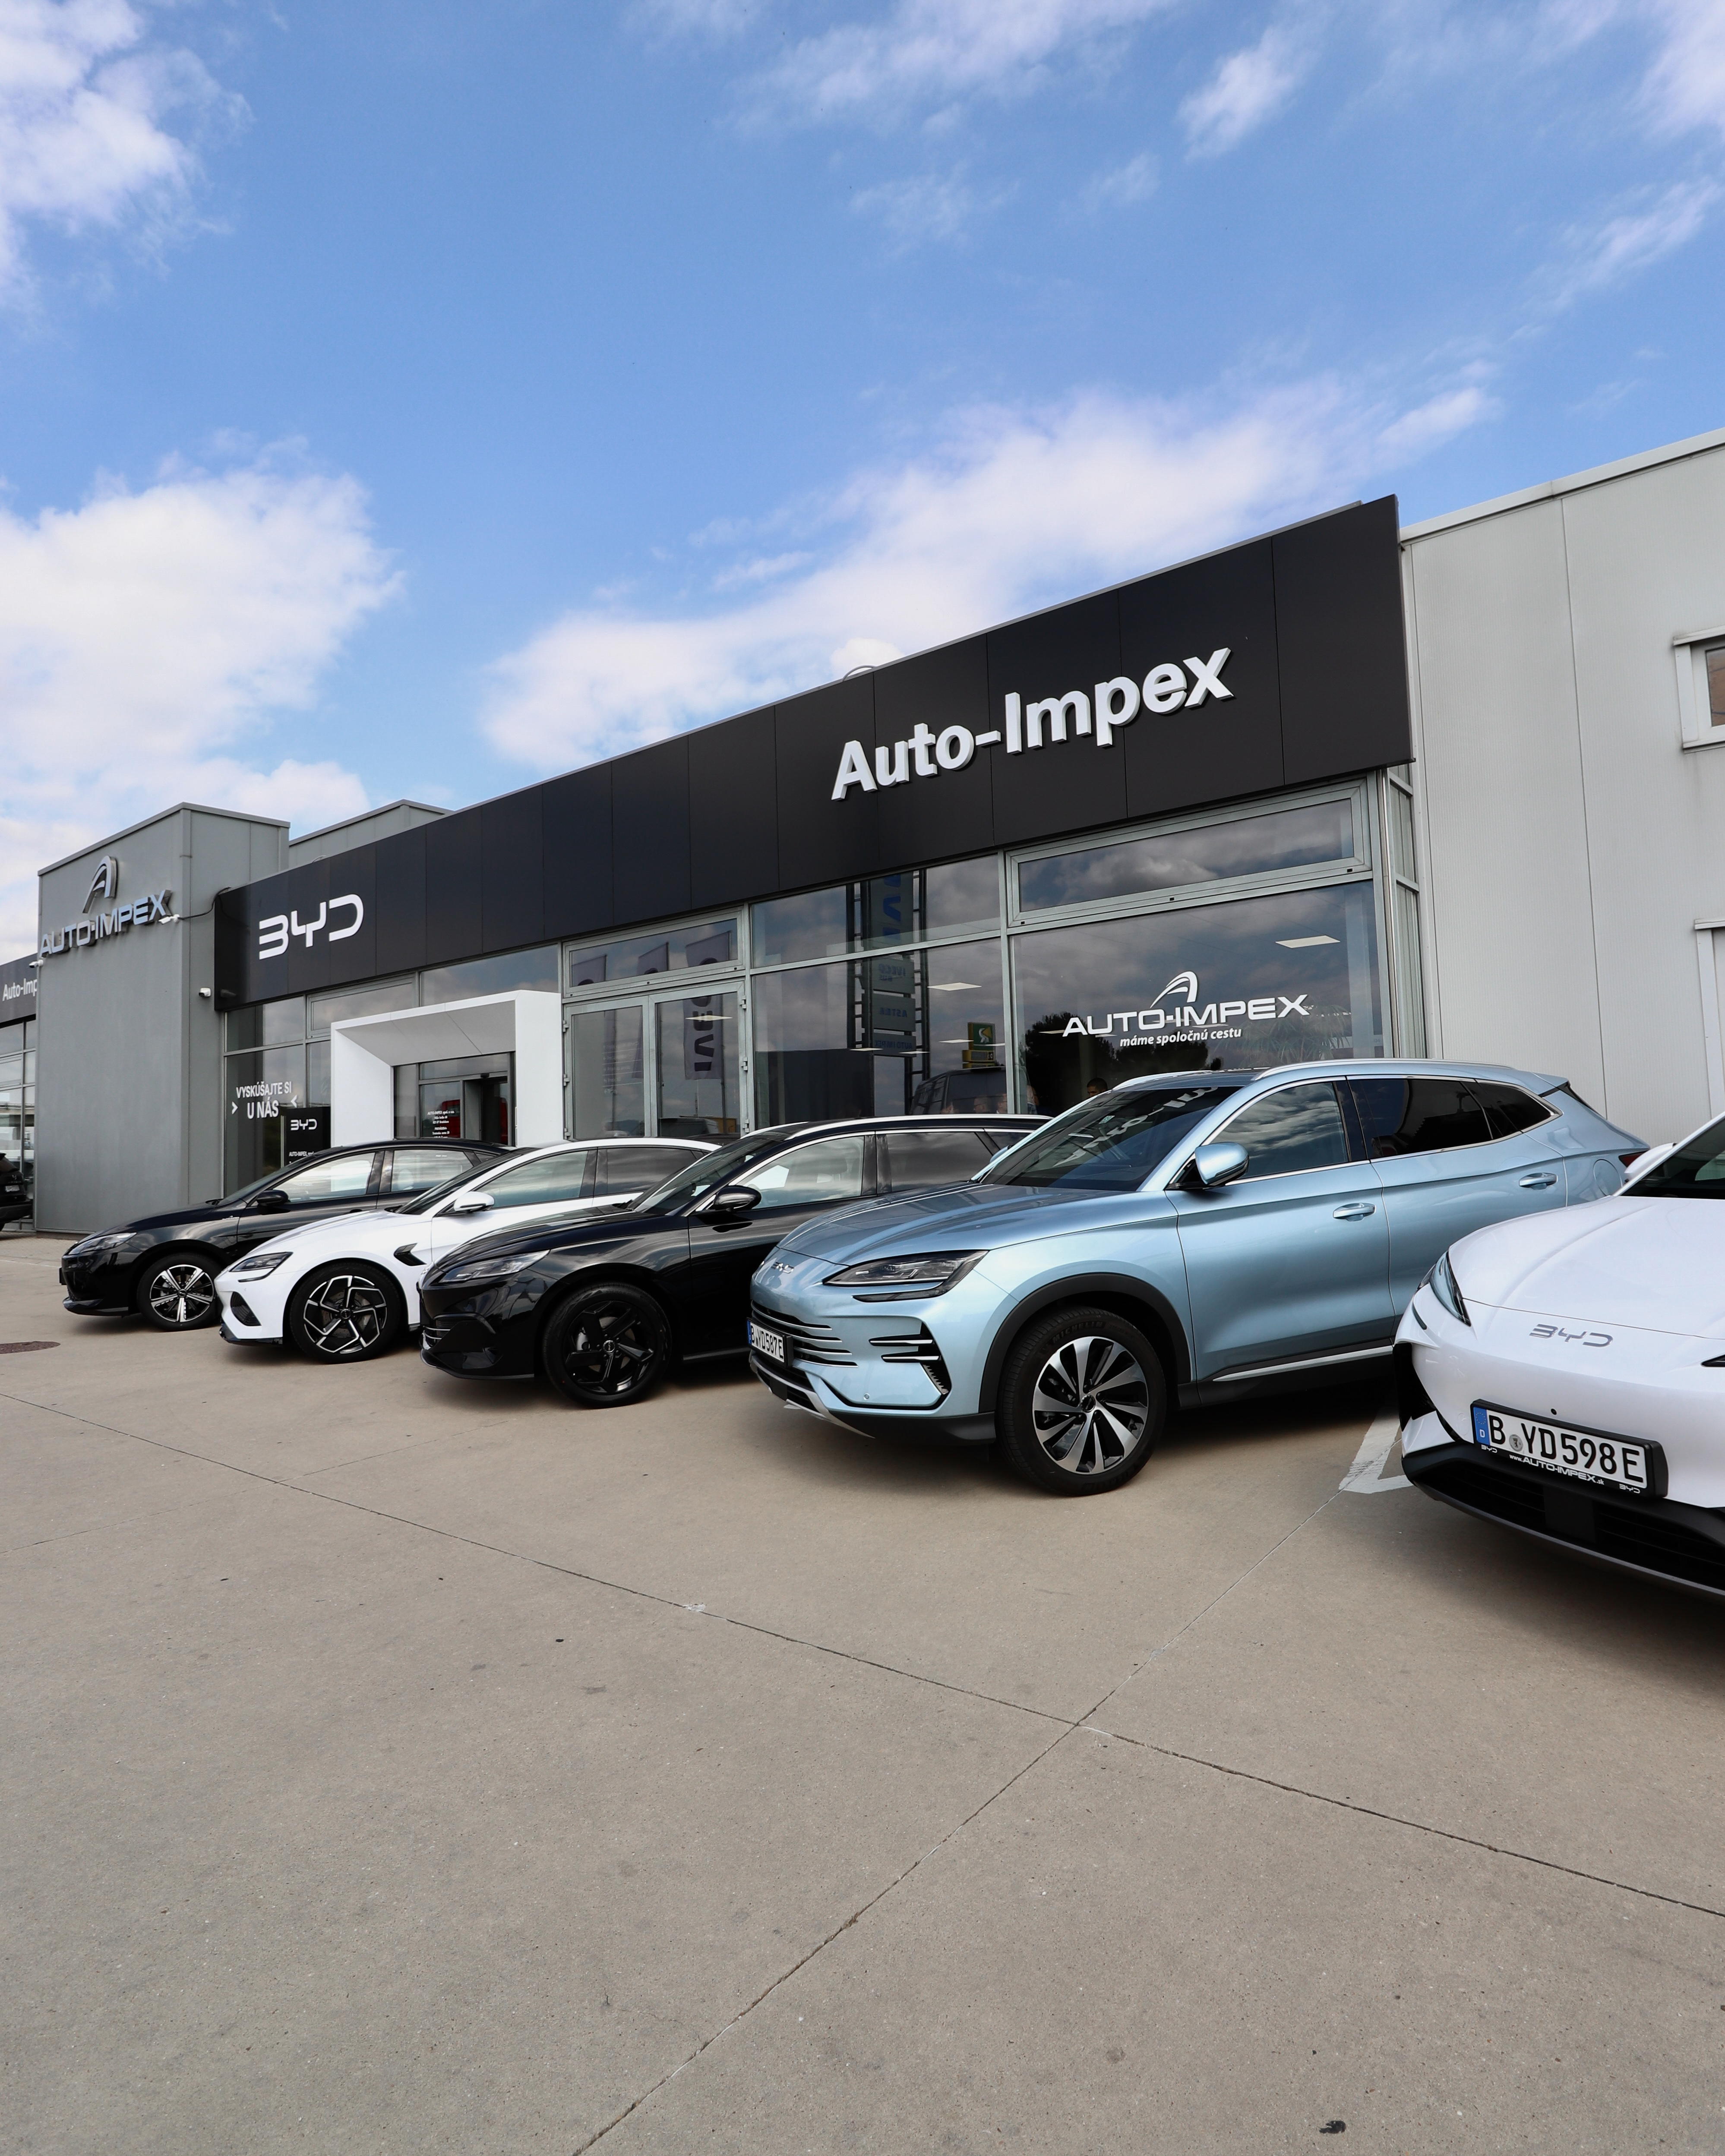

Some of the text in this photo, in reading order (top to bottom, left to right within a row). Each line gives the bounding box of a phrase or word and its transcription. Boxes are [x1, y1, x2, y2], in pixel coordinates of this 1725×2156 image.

[831, 647, 1234, 801] Auto-Impex
[39, 890, 172, 958] AUTO-IMPEX
[259, 893, 364, 960] BYD
[2, 978, 38, 1001] Auto-Imp
[1062, 994, 1310, 1037] AUTO-IMPEX
[1120, 1028, 1242, 1047] máme spoločnú cestu
[236, 1081, 291, 1099] VYSKÚŠAJTE SI
[247, 1096, 279, 1119] U NÁS
[291, 1118, 317, 1131] BYD
[1529, 1323, 1614, 1348] BYD
[1479, 1429, 1485, 1438] D
[1488, 1415, 1644, 1483] B YD598E
